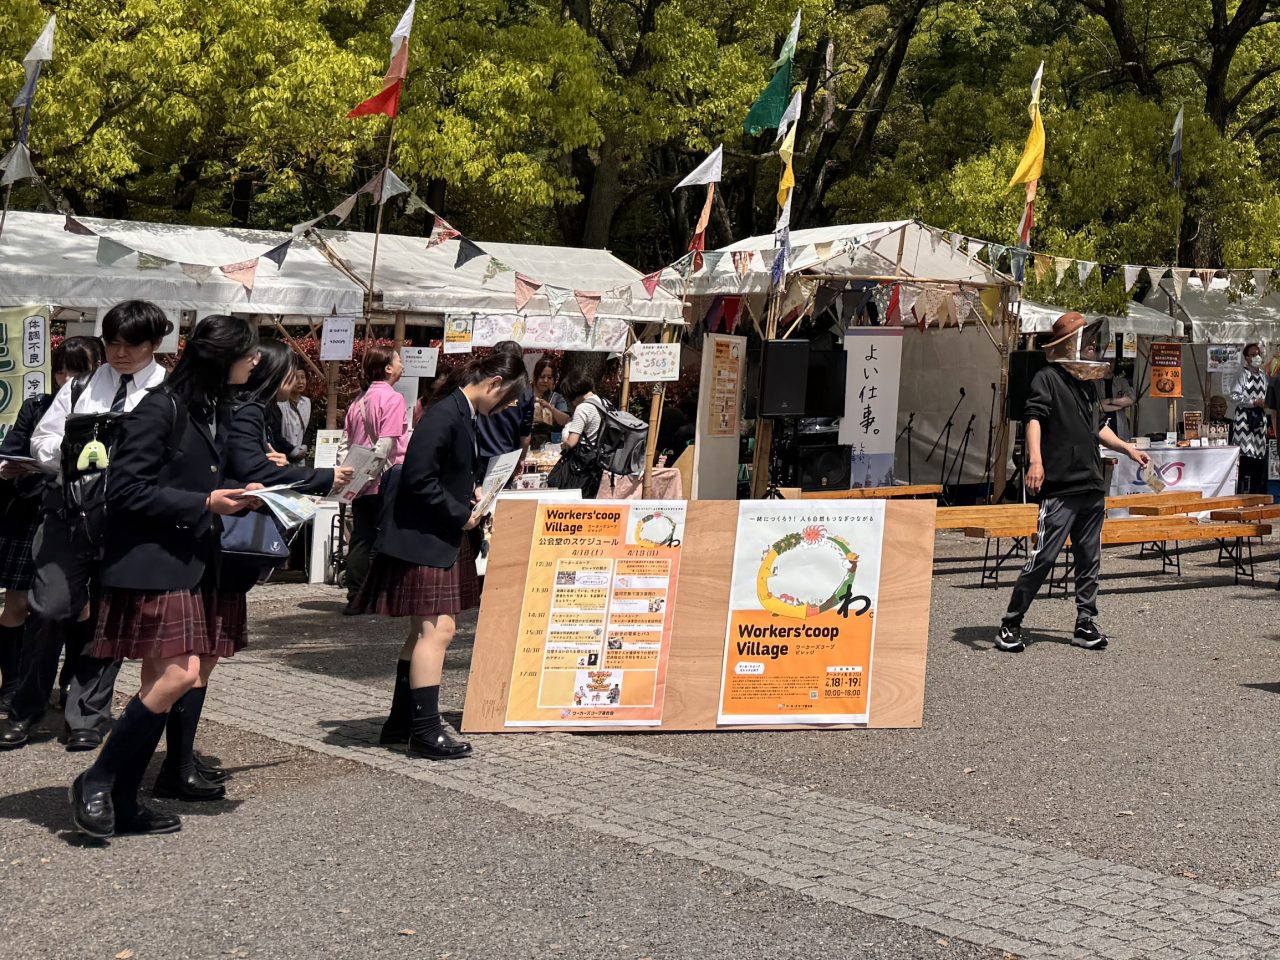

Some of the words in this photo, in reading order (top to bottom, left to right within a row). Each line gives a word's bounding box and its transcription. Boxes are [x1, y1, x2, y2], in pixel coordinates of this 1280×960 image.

[28, 320, 41, 364] 体調不良
[859, 344, 880, 435] よい仕事。
[547, 510, 620, 521] Workers'coop
[545, 522, 583, 534] Village
[539, 538, 619, 546] 公会堂のスケジュール
[738, 624, 839, 641] Workers'coop
[737, 641, 789, 659] Village
